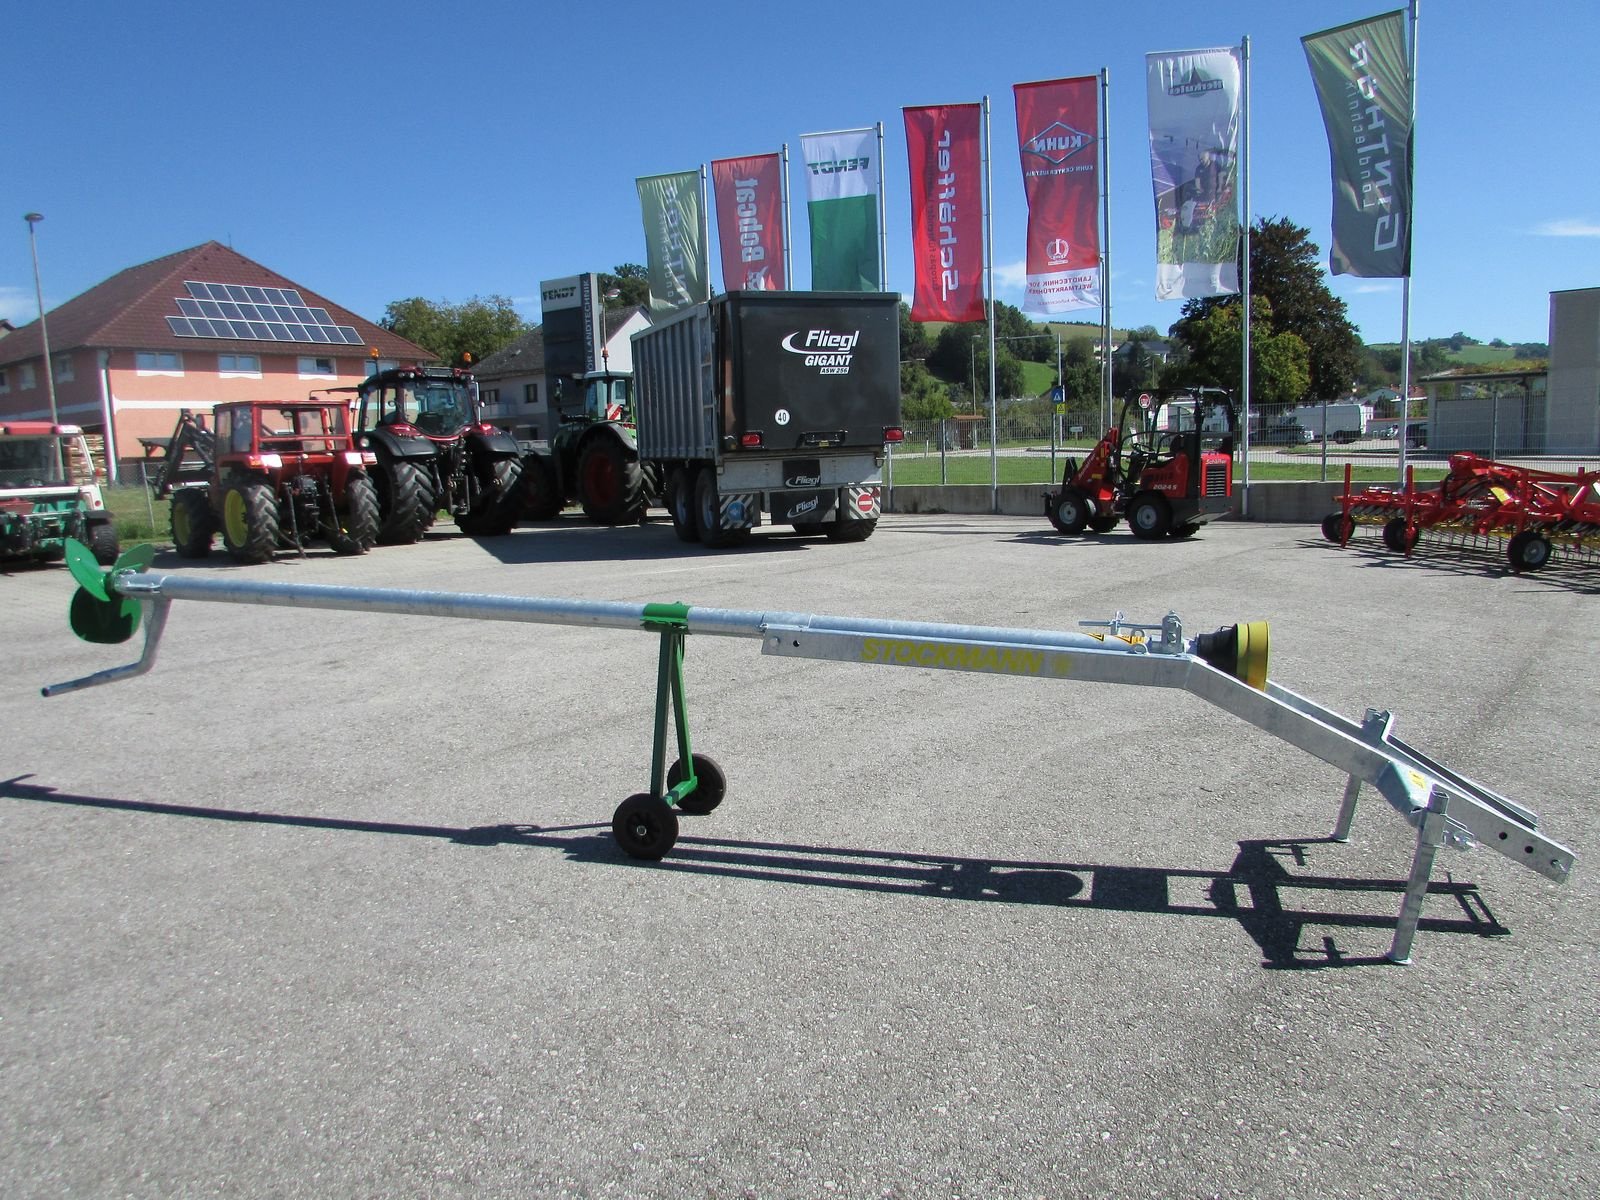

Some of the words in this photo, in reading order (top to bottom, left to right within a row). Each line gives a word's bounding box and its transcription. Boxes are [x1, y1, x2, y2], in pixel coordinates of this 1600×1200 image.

[542, 286, 577, 301] FENDT
[583, 280, 592, 353] LANDTECHNIK
[805, 330, 860, 351] Fliegl
[804, 355, 853, 366] GIGANT
[777, 412, 787, 422] 40
[795, 475, 821, 485] Fliegl
[795, 495, 819, 512] Fliegl
[862, 638, 1043, 673] STOCKMANN
